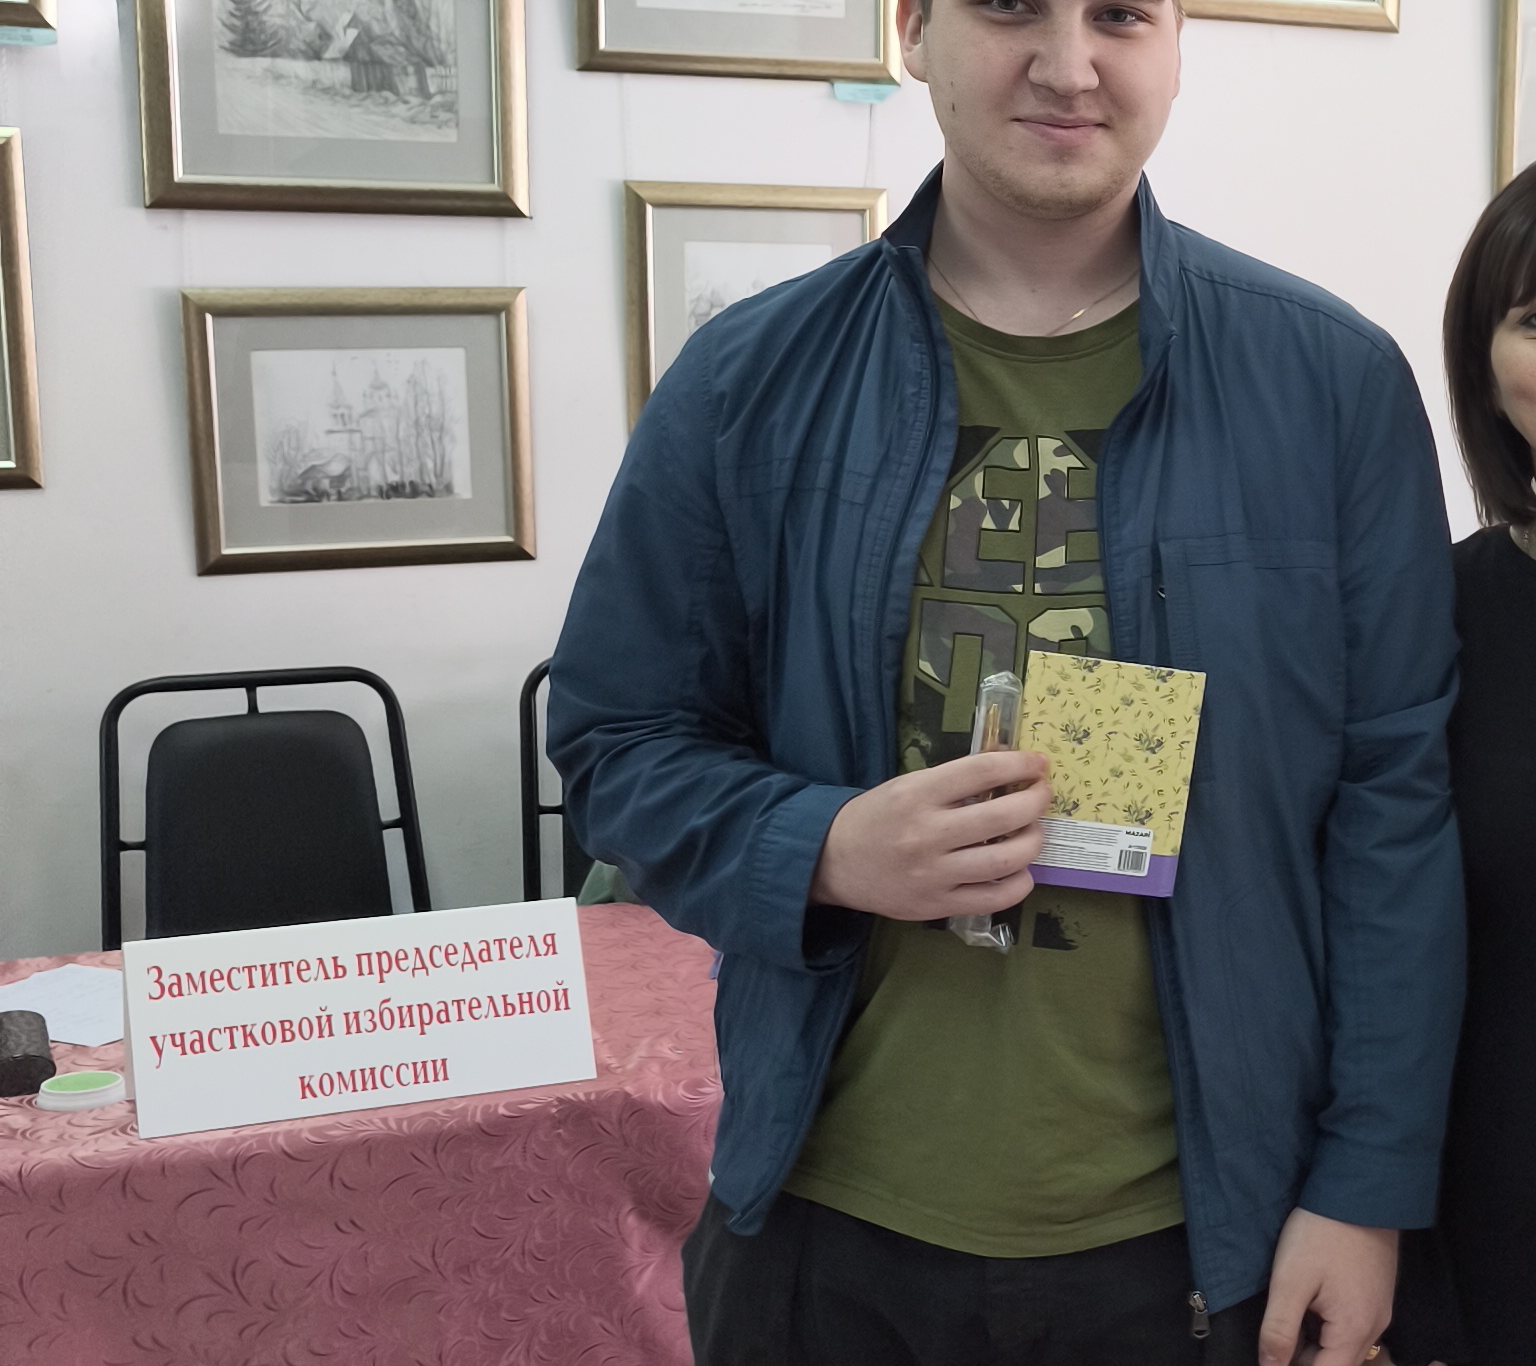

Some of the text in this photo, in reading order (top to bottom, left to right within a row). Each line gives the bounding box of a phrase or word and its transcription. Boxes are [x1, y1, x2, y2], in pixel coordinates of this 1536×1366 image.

[147, 957, 347, 1002] Заместитель
[355, 931, 558, 984] председателя
[148, 980, 571, 1069] участковой избирательной
[297, 1055, 450, 1100] комиссии
